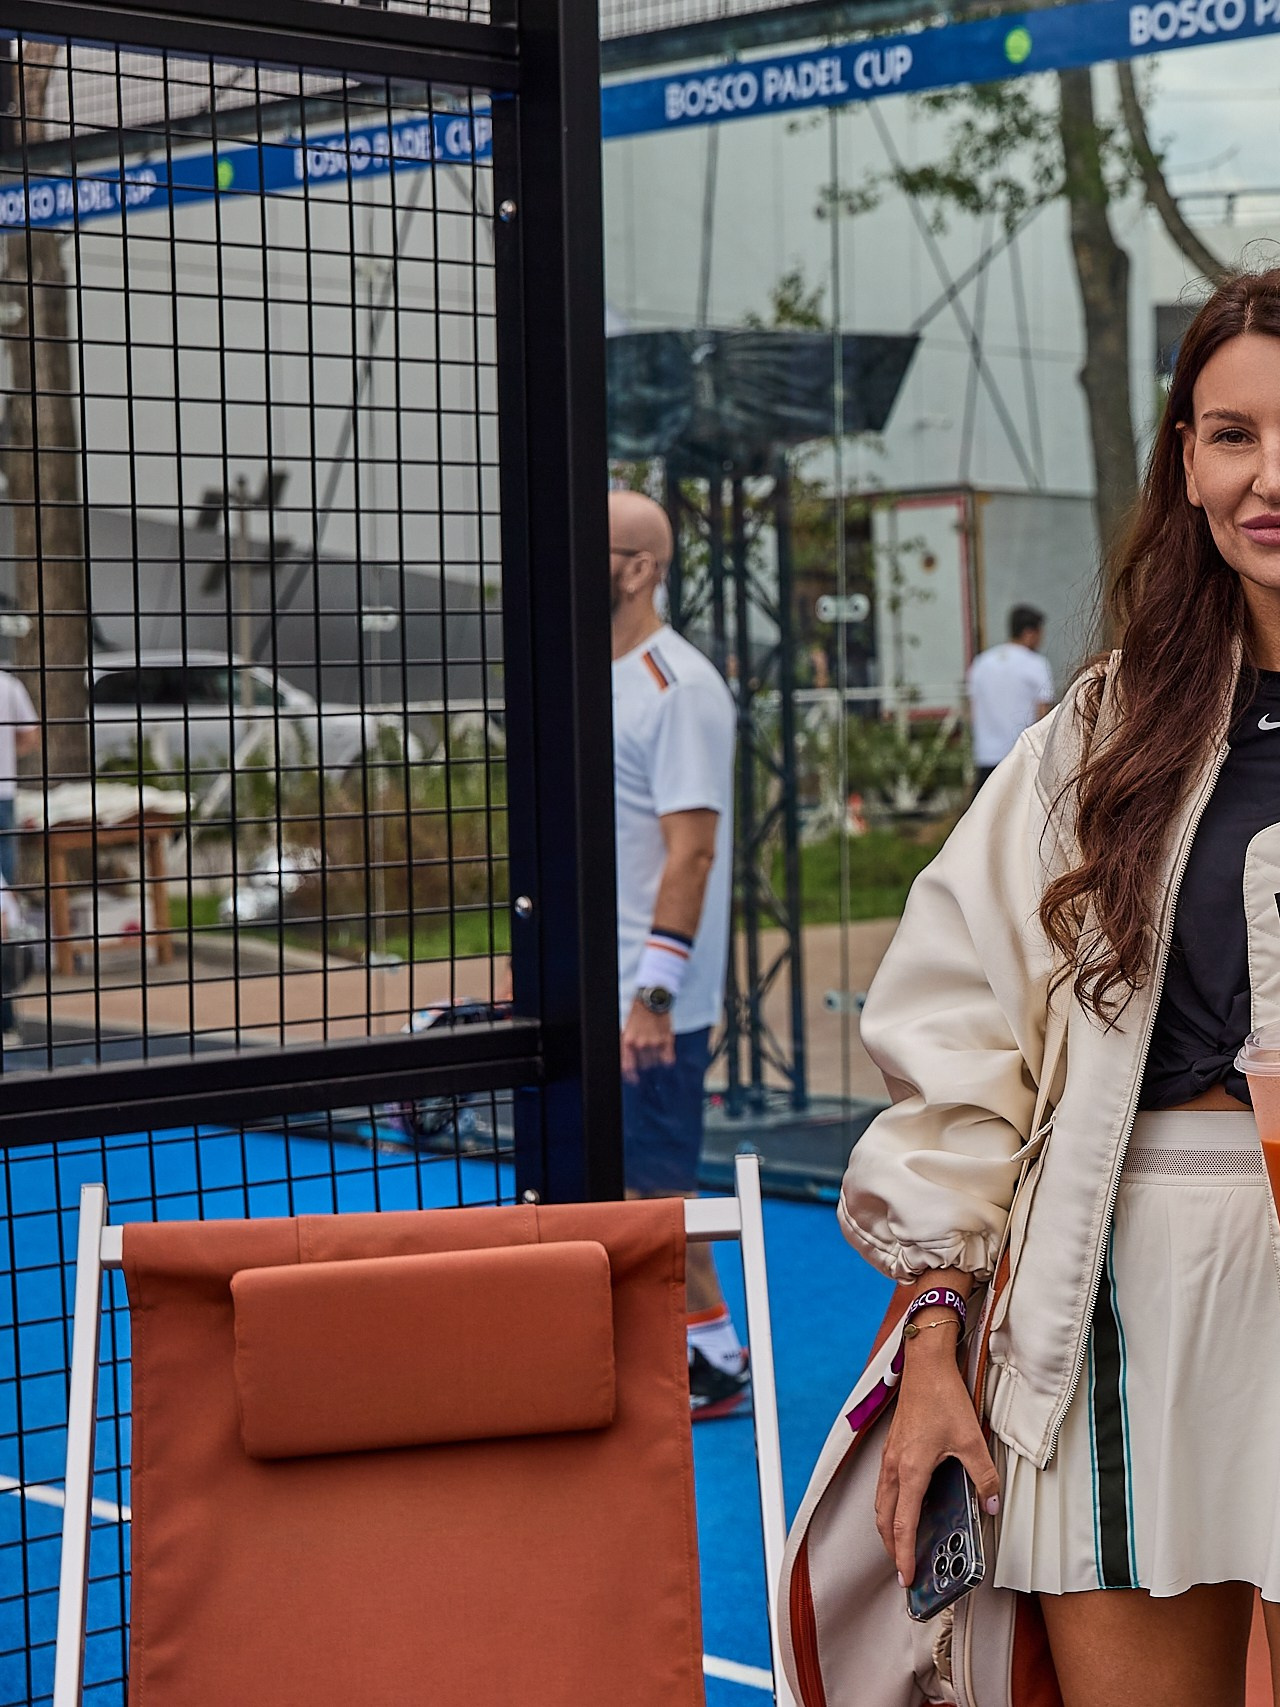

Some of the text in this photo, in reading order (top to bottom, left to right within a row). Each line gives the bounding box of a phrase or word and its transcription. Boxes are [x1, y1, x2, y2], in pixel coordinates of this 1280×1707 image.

[1129, 0, 1247, 46] BOSCO
[664, 44, 913, 120] BOSCO PADEL CUP
